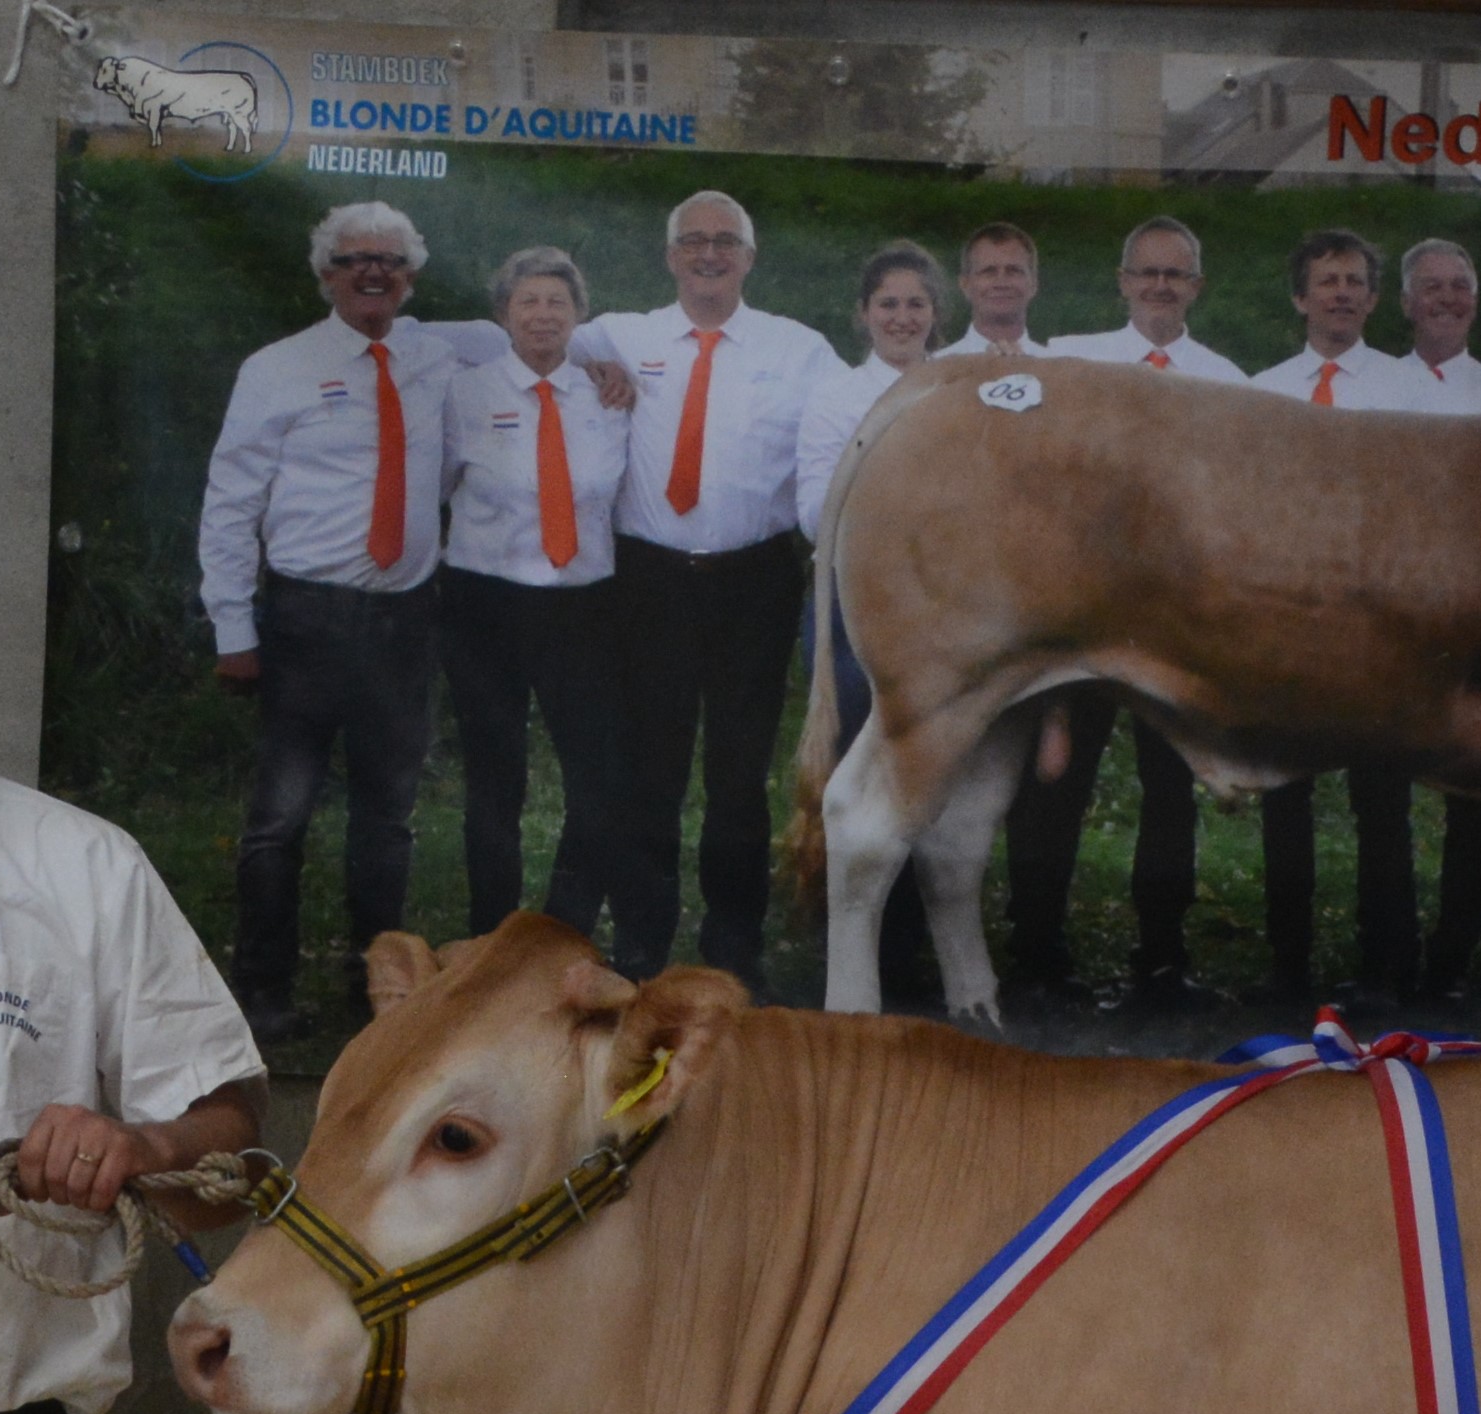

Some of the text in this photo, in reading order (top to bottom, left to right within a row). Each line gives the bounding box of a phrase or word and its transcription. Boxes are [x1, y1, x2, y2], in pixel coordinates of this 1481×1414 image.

[311, 50, 450, 87] STAMBOEK
[310, 99, 696, 145] BLONDE D'AQUITAINE
[307, 143, 448, 180] NEDERLAND
[988, 383, 1027, 401] 06
